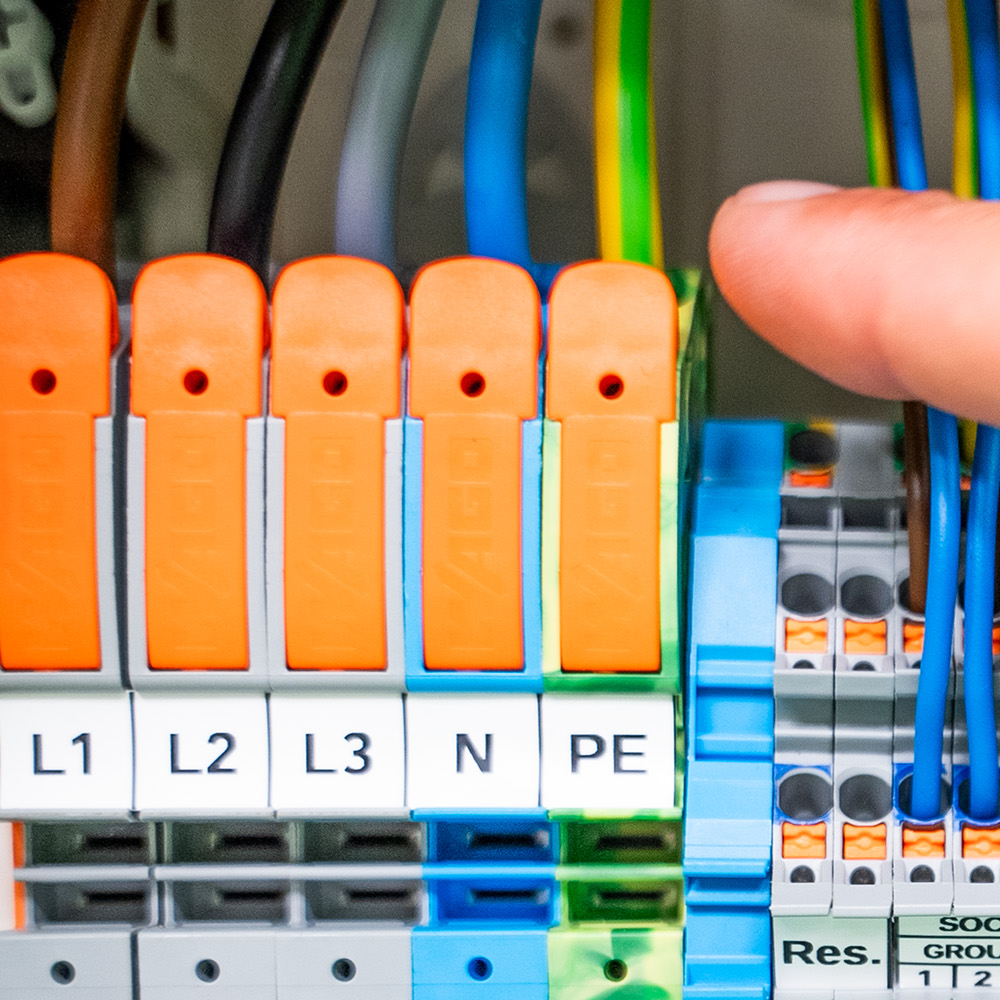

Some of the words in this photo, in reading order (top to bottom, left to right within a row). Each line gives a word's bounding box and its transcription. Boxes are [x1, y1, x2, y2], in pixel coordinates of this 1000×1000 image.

[32, 732, 91, 774] L1
[170, 732, 236, 774] L2
[305, 732, 371, 774] L3
[455, 732, 493, 773] N
[570, 733, 647, 773] PE
[782, 940, 881, 967] Res.
[918, 970, 931, 987] 1
[974, 970, 992, 987] 2
